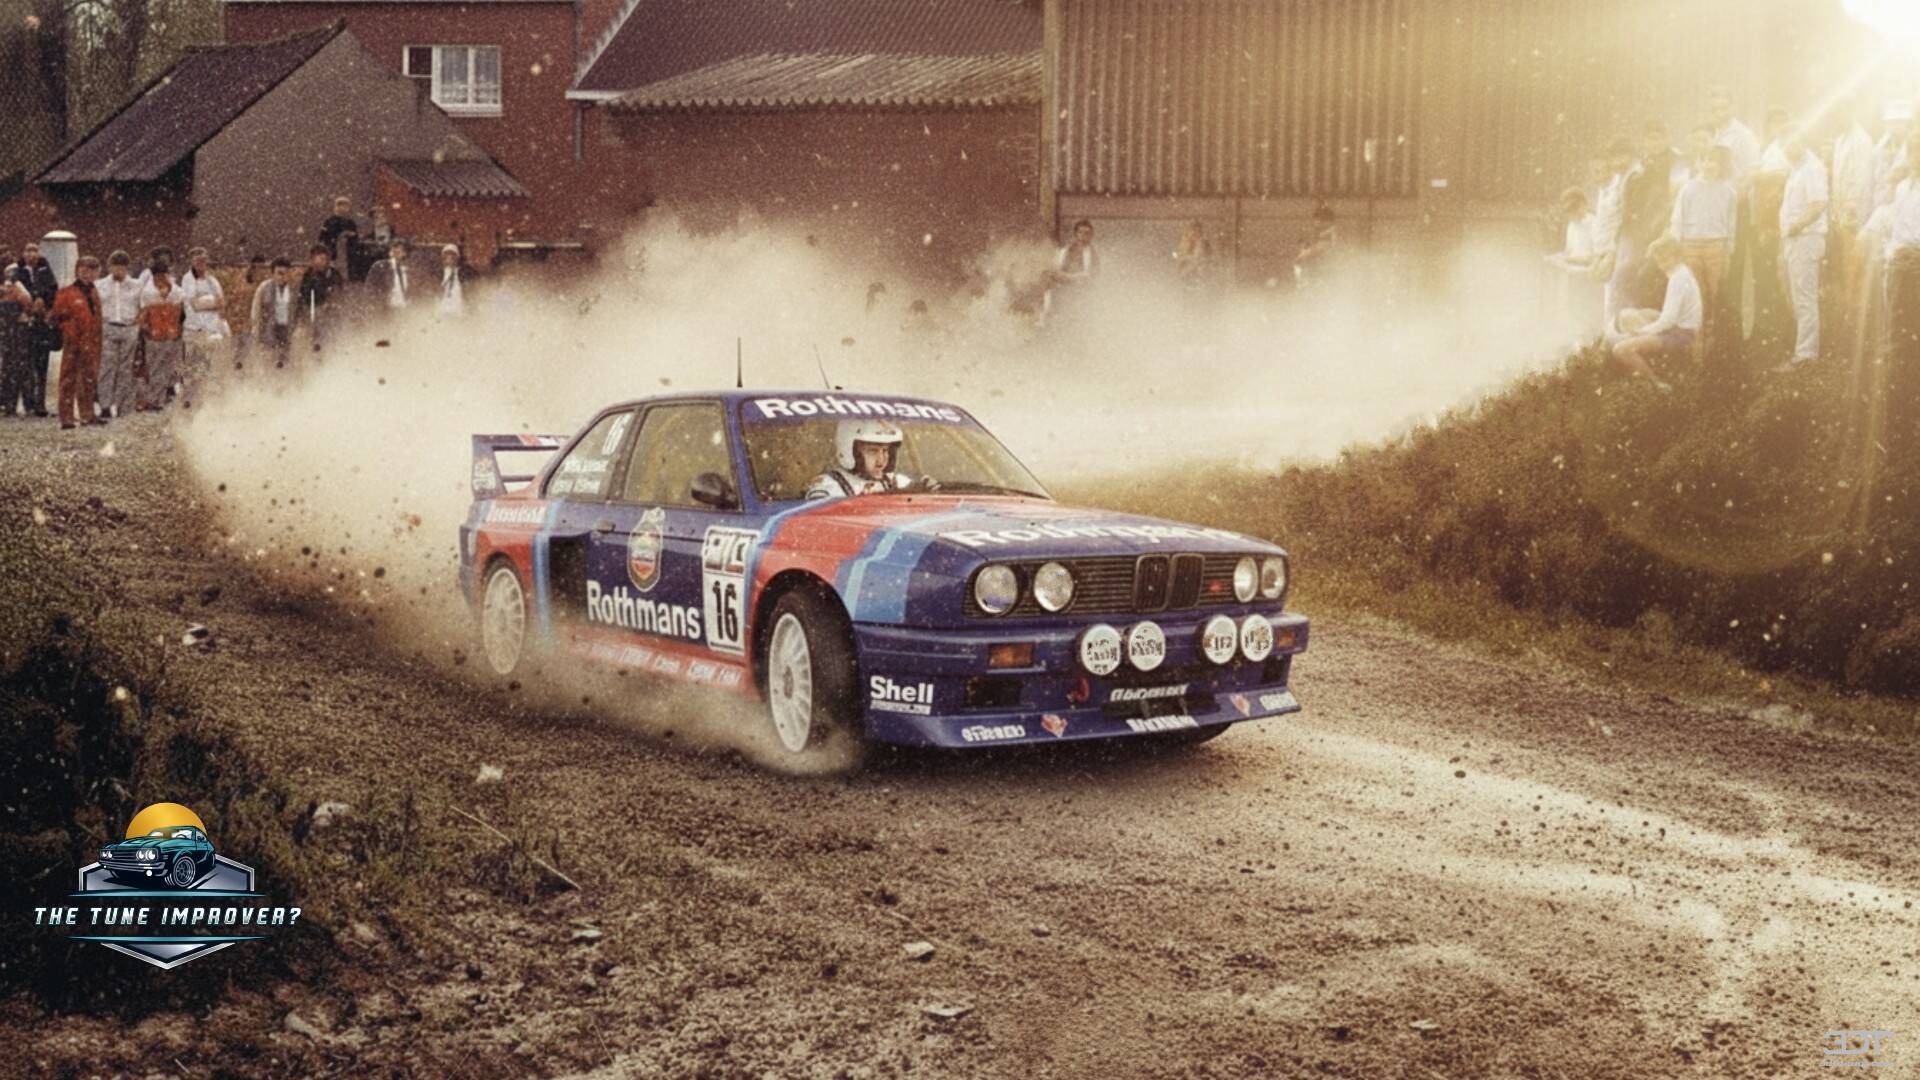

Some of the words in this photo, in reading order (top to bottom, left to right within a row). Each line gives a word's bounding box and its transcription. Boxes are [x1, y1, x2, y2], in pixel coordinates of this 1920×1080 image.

[754, 395, 961, 422] Rothmans
[586, 579, 701, 640] Rothmans
[712, 580, 739, 643] 16
[869, 675, 934, 704] Shell
